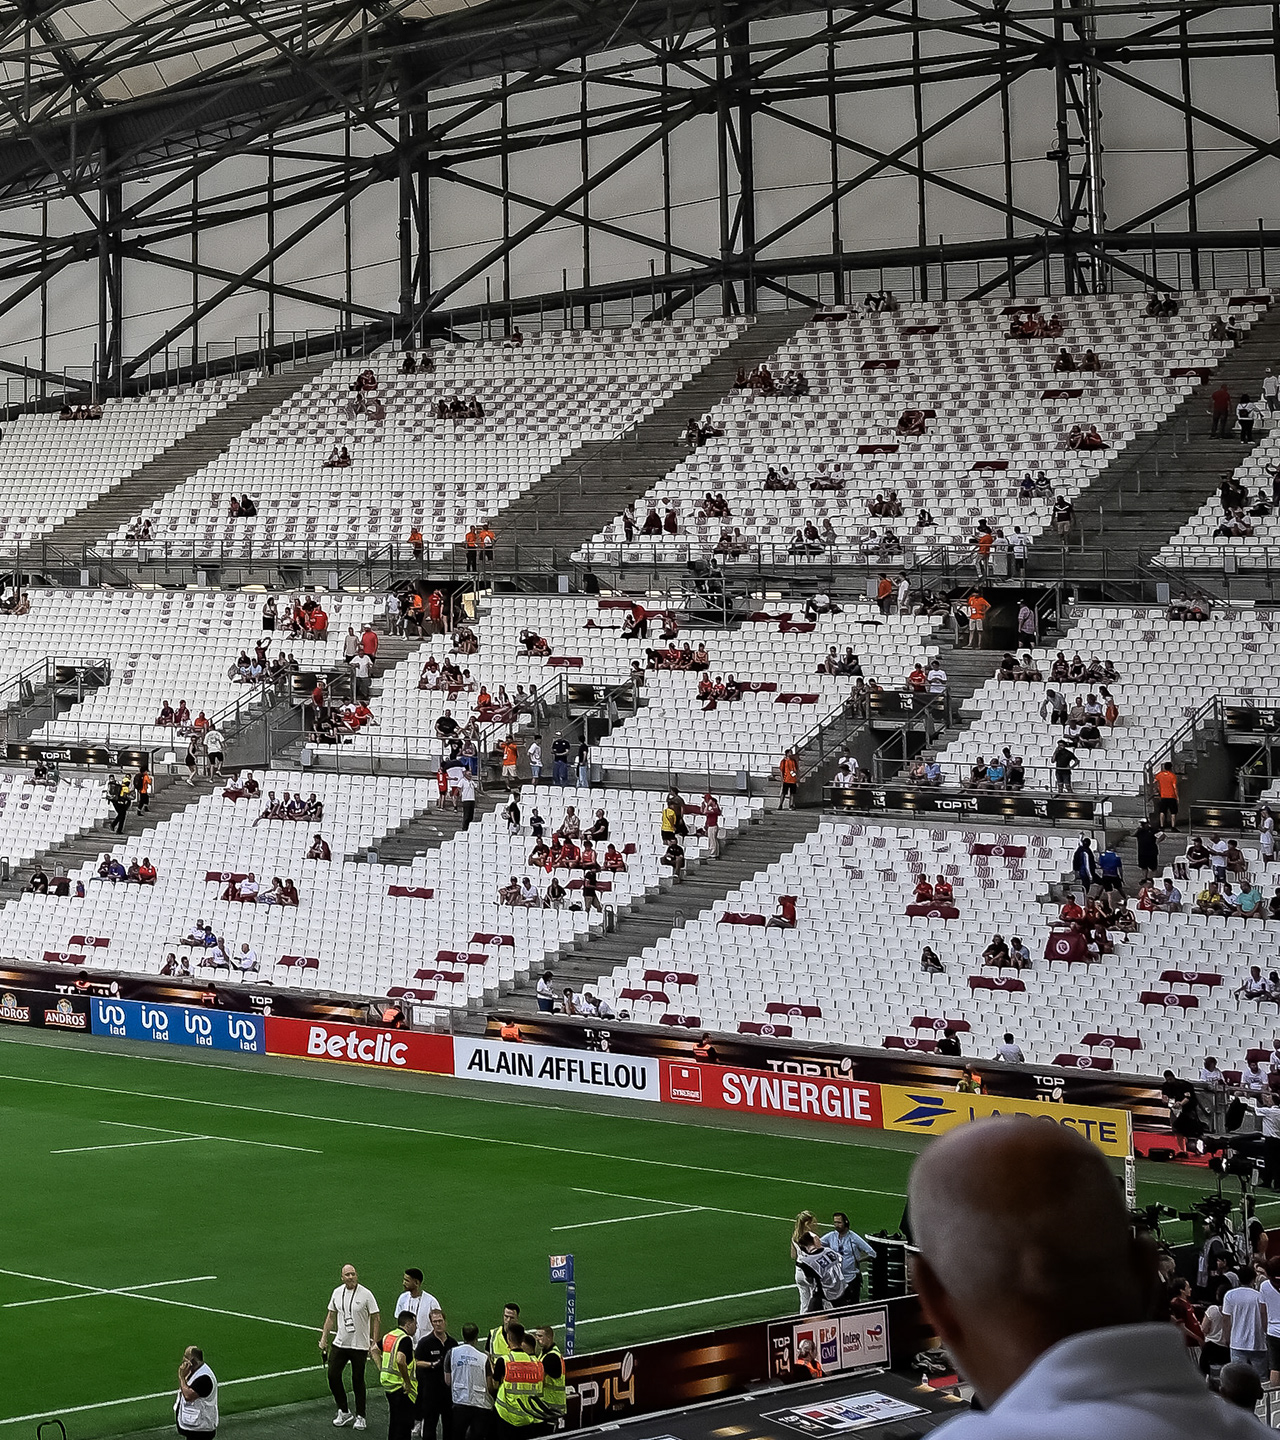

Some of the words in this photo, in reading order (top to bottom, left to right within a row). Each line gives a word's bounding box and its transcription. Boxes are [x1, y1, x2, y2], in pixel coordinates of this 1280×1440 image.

[249, 995, 273, 1005] TOP
[45, 1012, 85, 1026] ANDROS
[307, 1026, 409, 1065] Betclic
[467, 1048, 533, 1078] ALAIN
[538, 1056, 647, 1090] AFFLELOU
[1033, 1075, 1065, 1086] TOP
[672, 1088, 700, 1099] SYNERGIE
[722, 1072, 872, 1121] SYNERGIE
[773, 1336, 790, 1349] TOP
[821, 1345, 836, 1360] GMF
